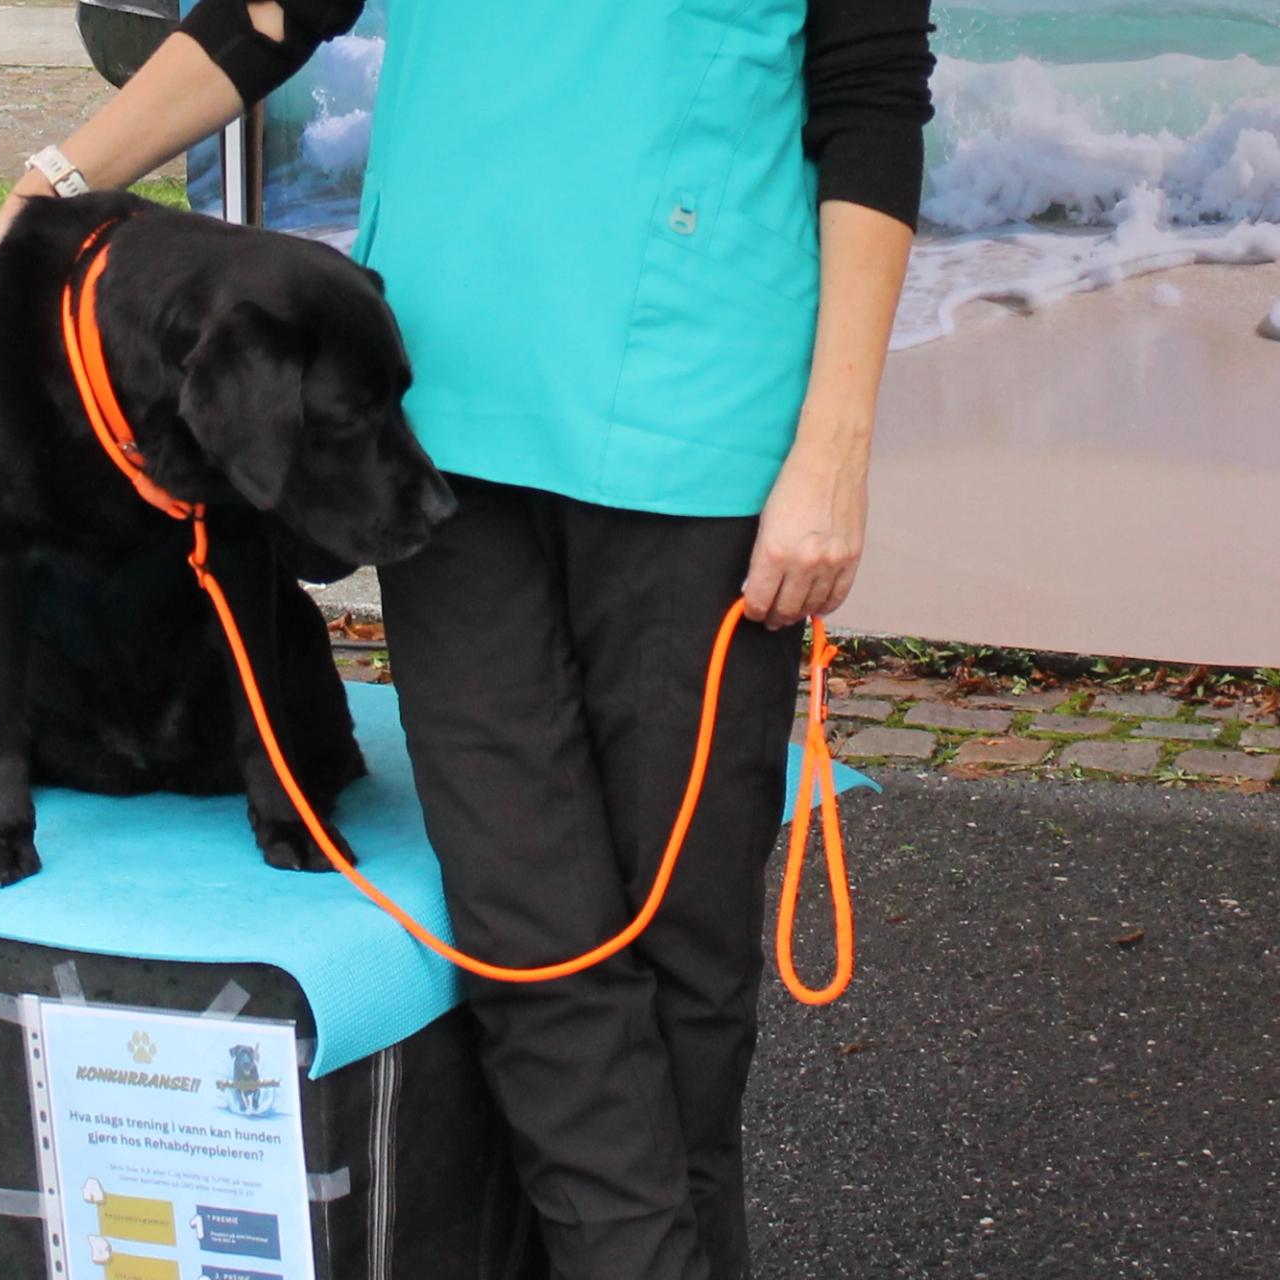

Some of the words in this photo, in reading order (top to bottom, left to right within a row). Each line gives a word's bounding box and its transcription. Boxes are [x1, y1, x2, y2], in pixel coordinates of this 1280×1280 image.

[69, 1110, 91, 1123] Hva
[94, 1113, 125, 1128] slags
[127, 1116, 169, 1134] trening
[178, 1124, 207, 1137] vann
[210, 1125, 232, 1139] kan
[235, 1127, 281, 1144] hunden
[88, 1131, 118, 1146] gjøre
[121, 1134, 141, 1147] hos
